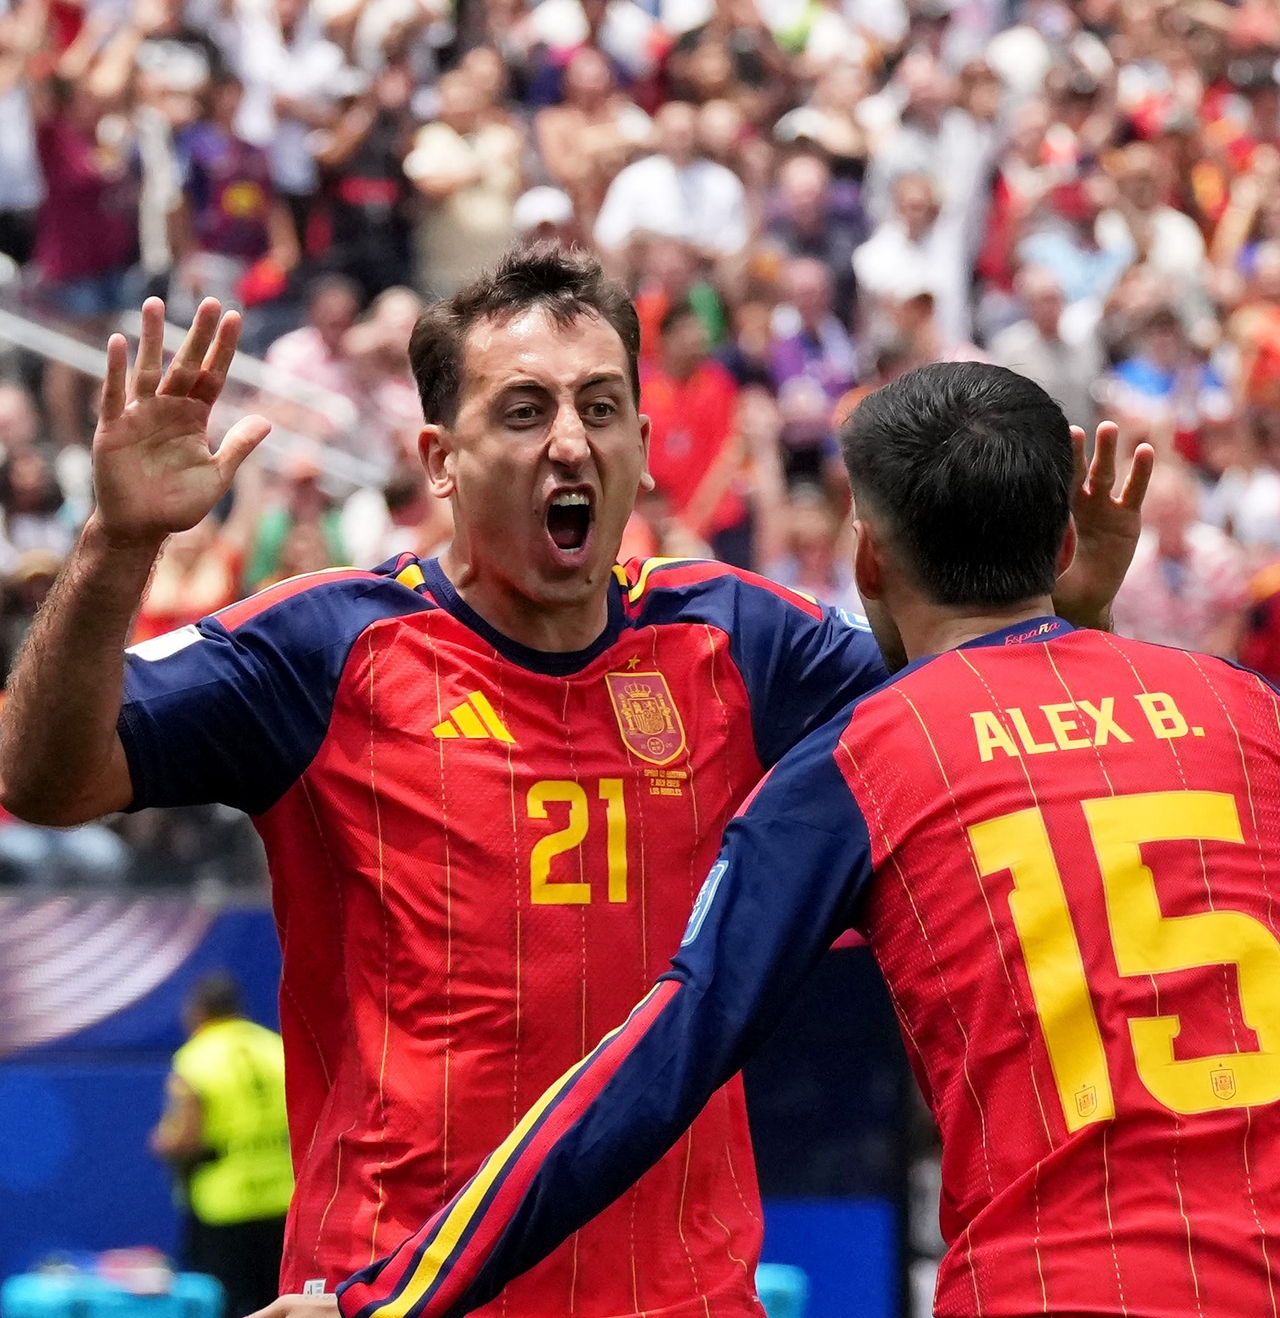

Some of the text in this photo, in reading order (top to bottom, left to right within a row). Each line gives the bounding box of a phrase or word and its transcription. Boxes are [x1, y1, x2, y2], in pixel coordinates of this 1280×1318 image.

[1004, 622, 1061, 646] España
[969, 692, 1205, 763] ALEX B.
[526, 778, 628, 905] 21
